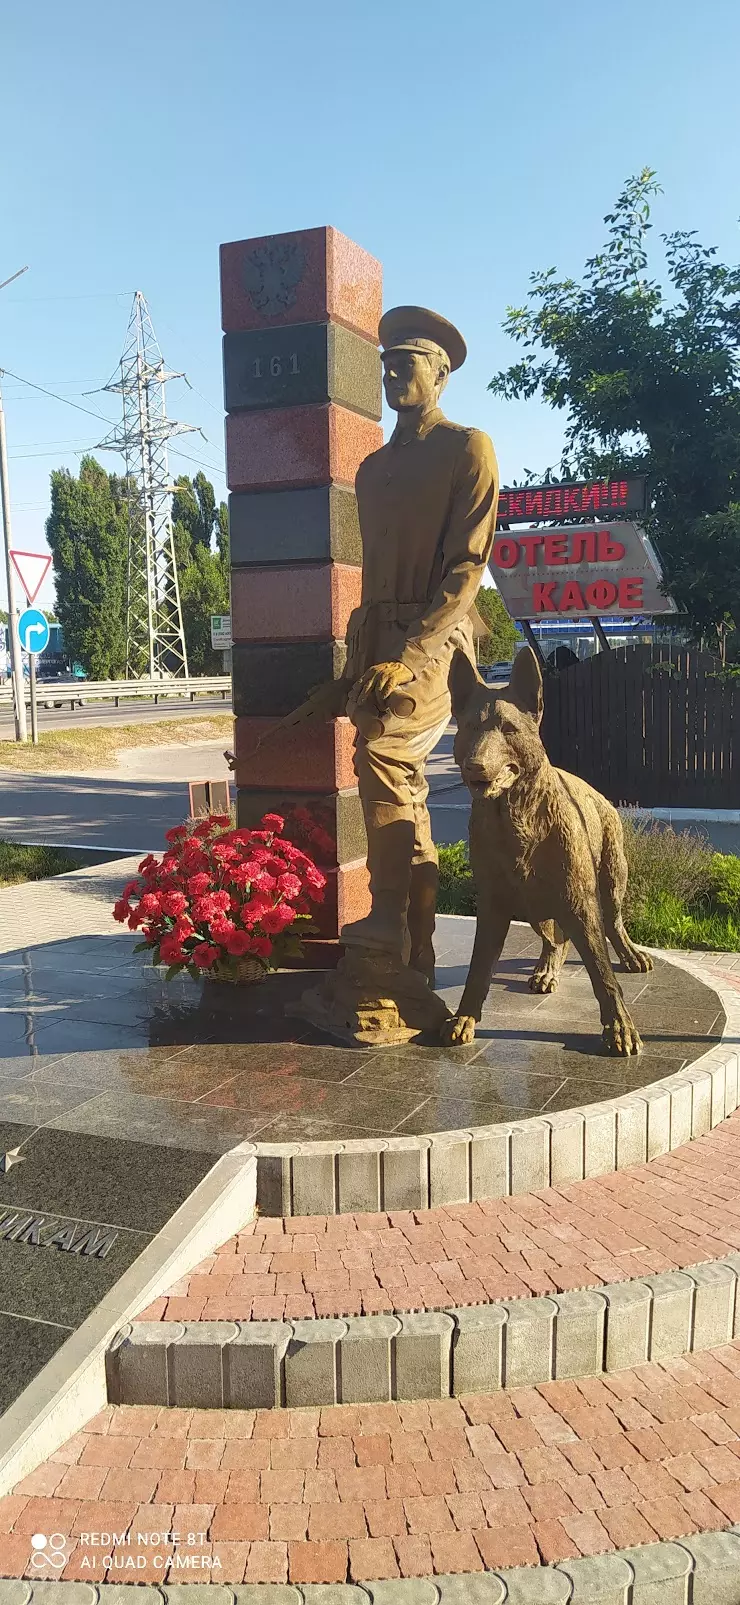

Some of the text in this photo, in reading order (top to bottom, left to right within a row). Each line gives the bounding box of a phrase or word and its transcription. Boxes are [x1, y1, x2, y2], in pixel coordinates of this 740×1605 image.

[252, 353, 301, 378] 161
[492, 530, 626, 569] ОТЕЛЬ
[532, 577, 644, 613] КАФЕ
[0, 1211, 118, 1259] ИКАМ
